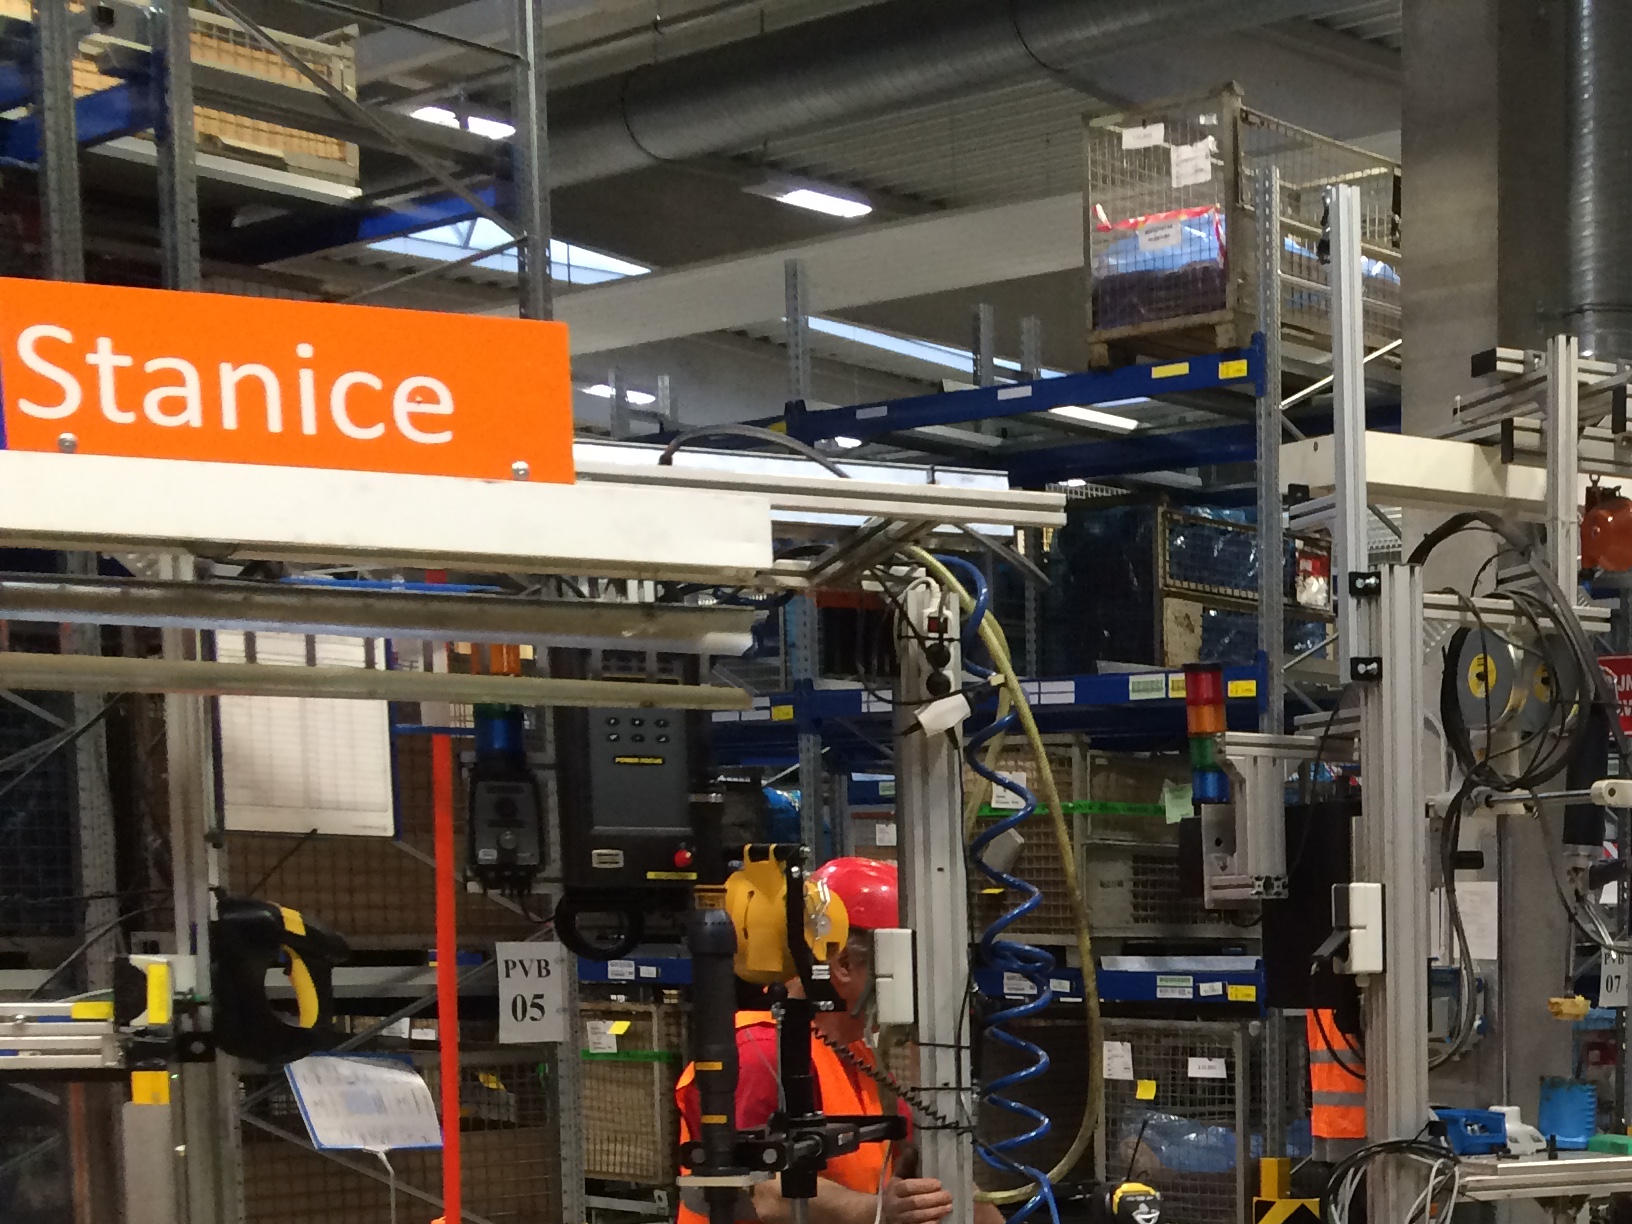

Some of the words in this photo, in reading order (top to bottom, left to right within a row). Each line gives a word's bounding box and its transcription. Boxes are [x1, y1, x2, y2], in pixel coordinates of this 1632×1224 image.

[16, 324, 455, 445] Stanice
[503, 958, 552, 979] PVB
[1605, 974, 1622, 993] 07
[511, 993, 546, 1023] 05
